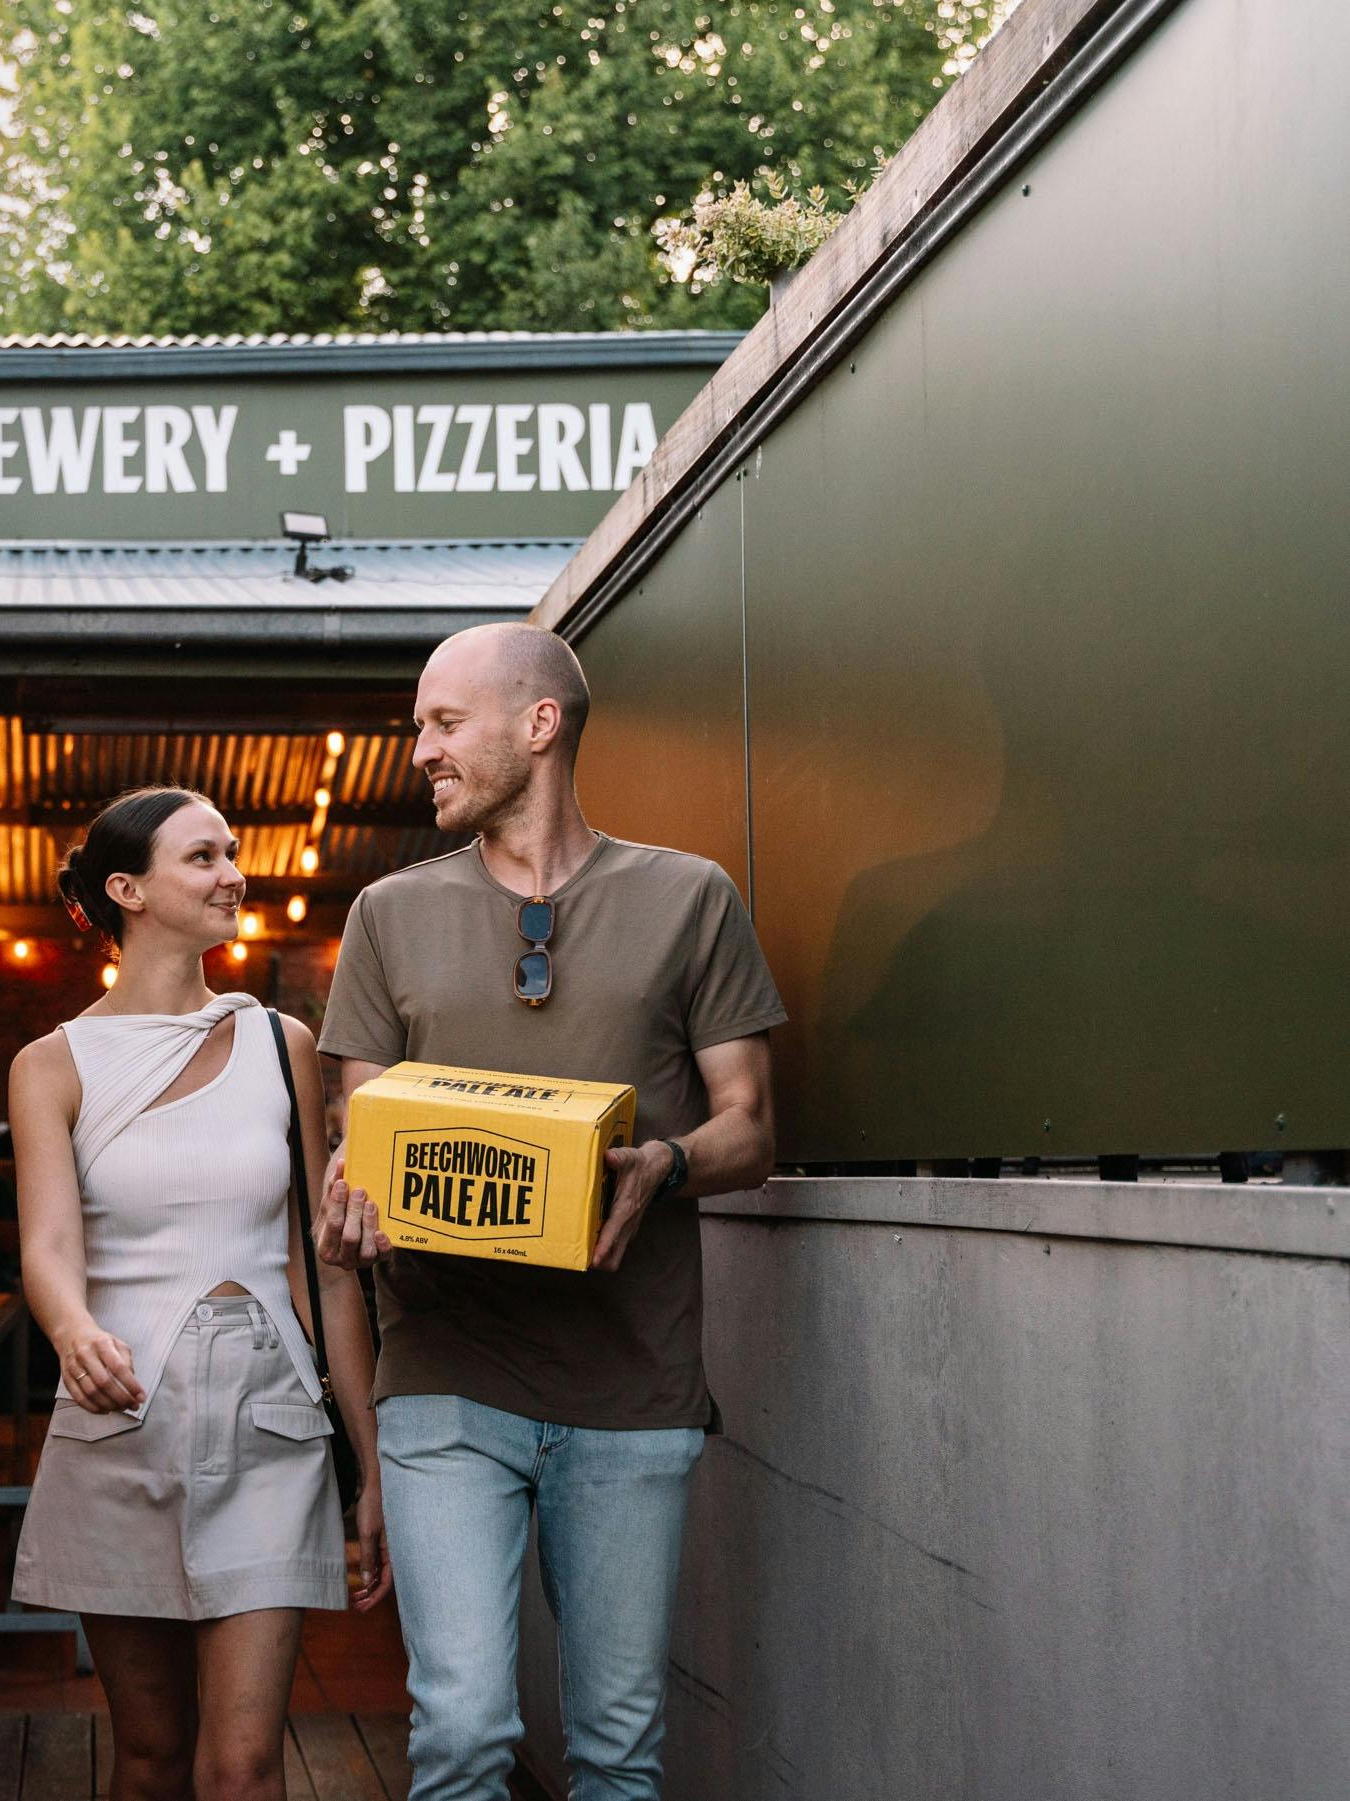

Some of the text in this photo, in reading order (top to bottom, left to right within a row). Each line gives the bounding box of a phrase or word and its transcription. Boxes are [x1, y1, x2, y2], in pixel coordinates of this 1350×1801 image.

[264, 430, 312, 475] +
[343, 402, 659, 493] PIZZERIA
[428, 1080, 499, 1097] PALE
[500, 1088, 558, 1101] ALE
[405, 1140, 536, 1183] BEECHWORTH
[402, 1172, 533, 1227] PALE ALE
[415, 1236, 429, 1245] ABV
